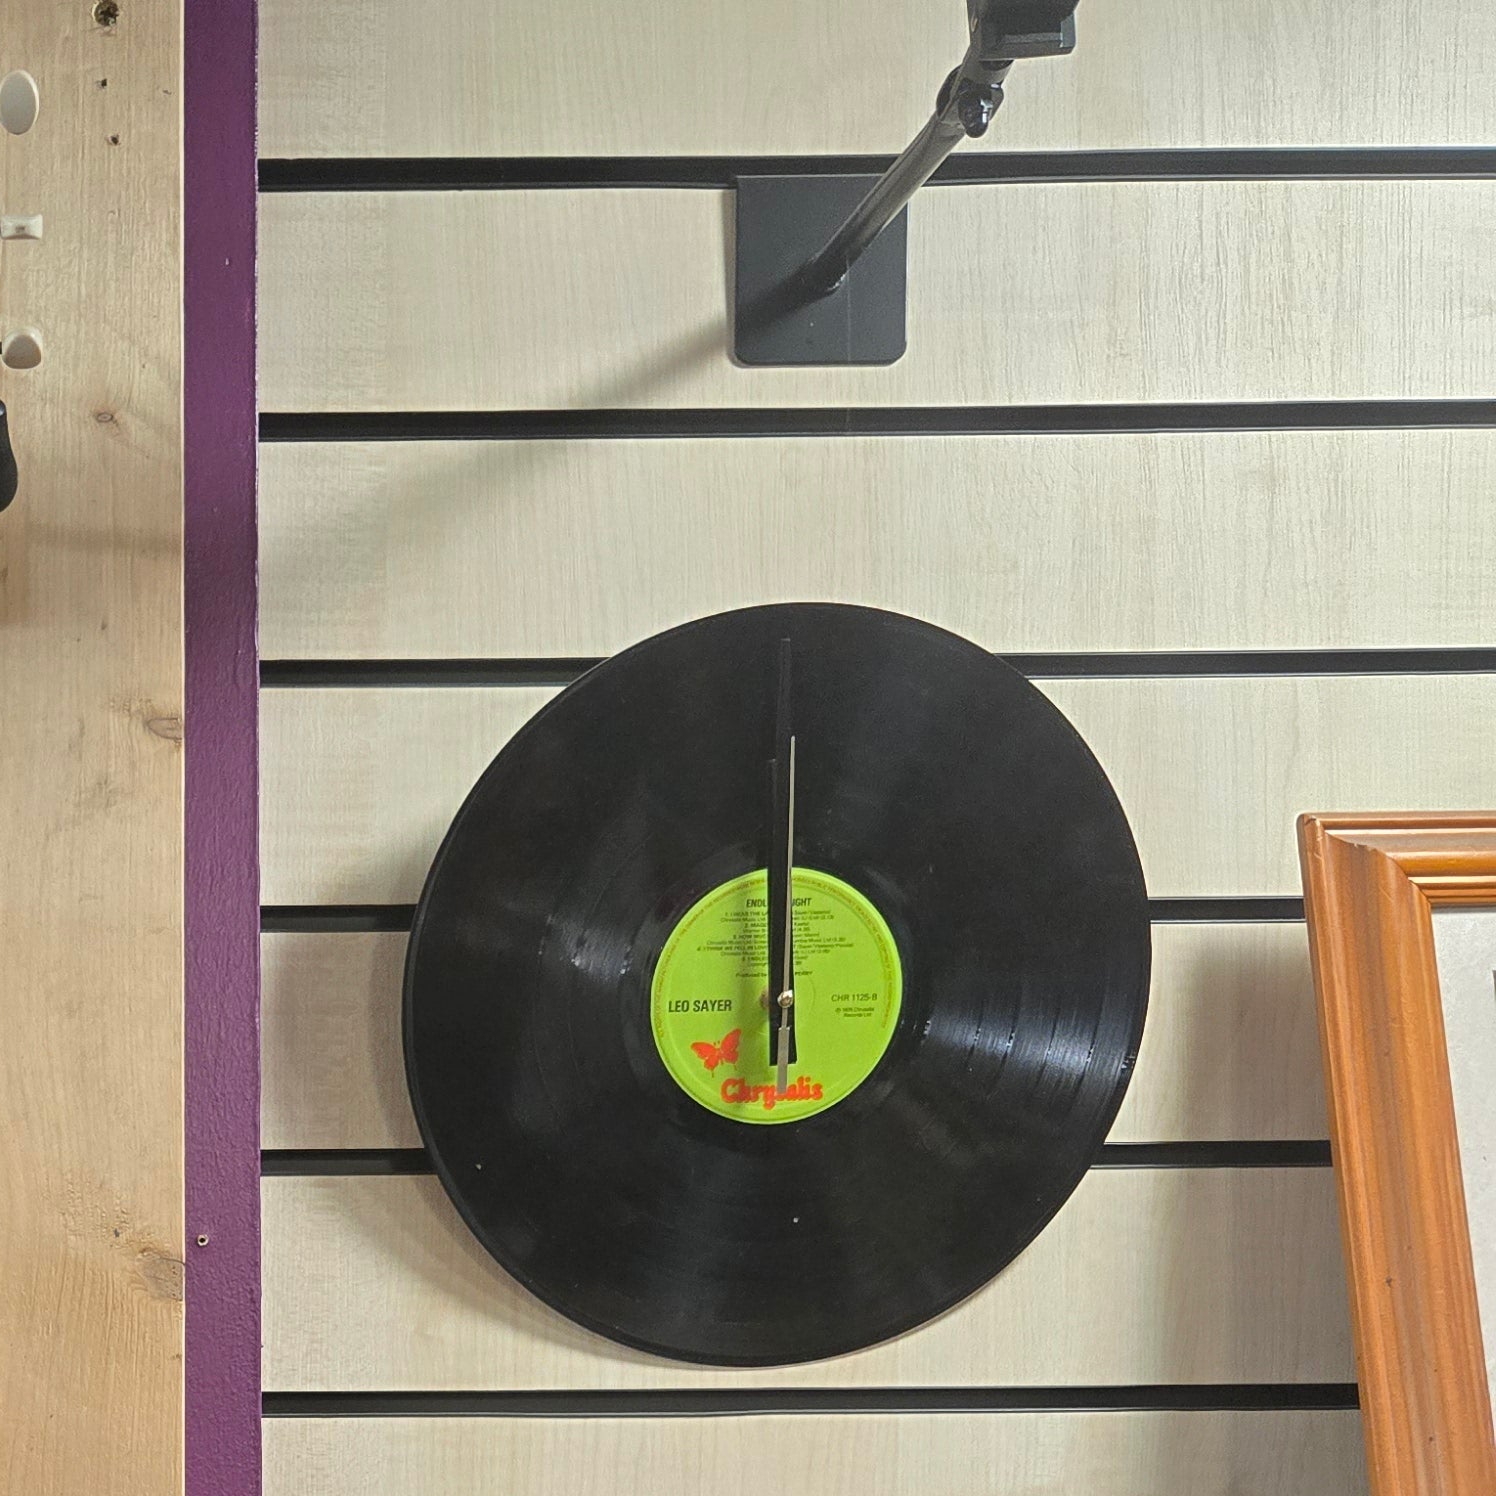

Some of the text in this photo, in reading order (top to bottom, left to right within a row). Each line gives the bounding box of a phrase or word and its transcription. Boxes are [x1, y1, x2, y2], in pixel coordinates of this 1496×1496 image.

[831, 993, 878, 1002] CHR 1125-B
[668, 1000, 732, 1012] LEO SAYER
